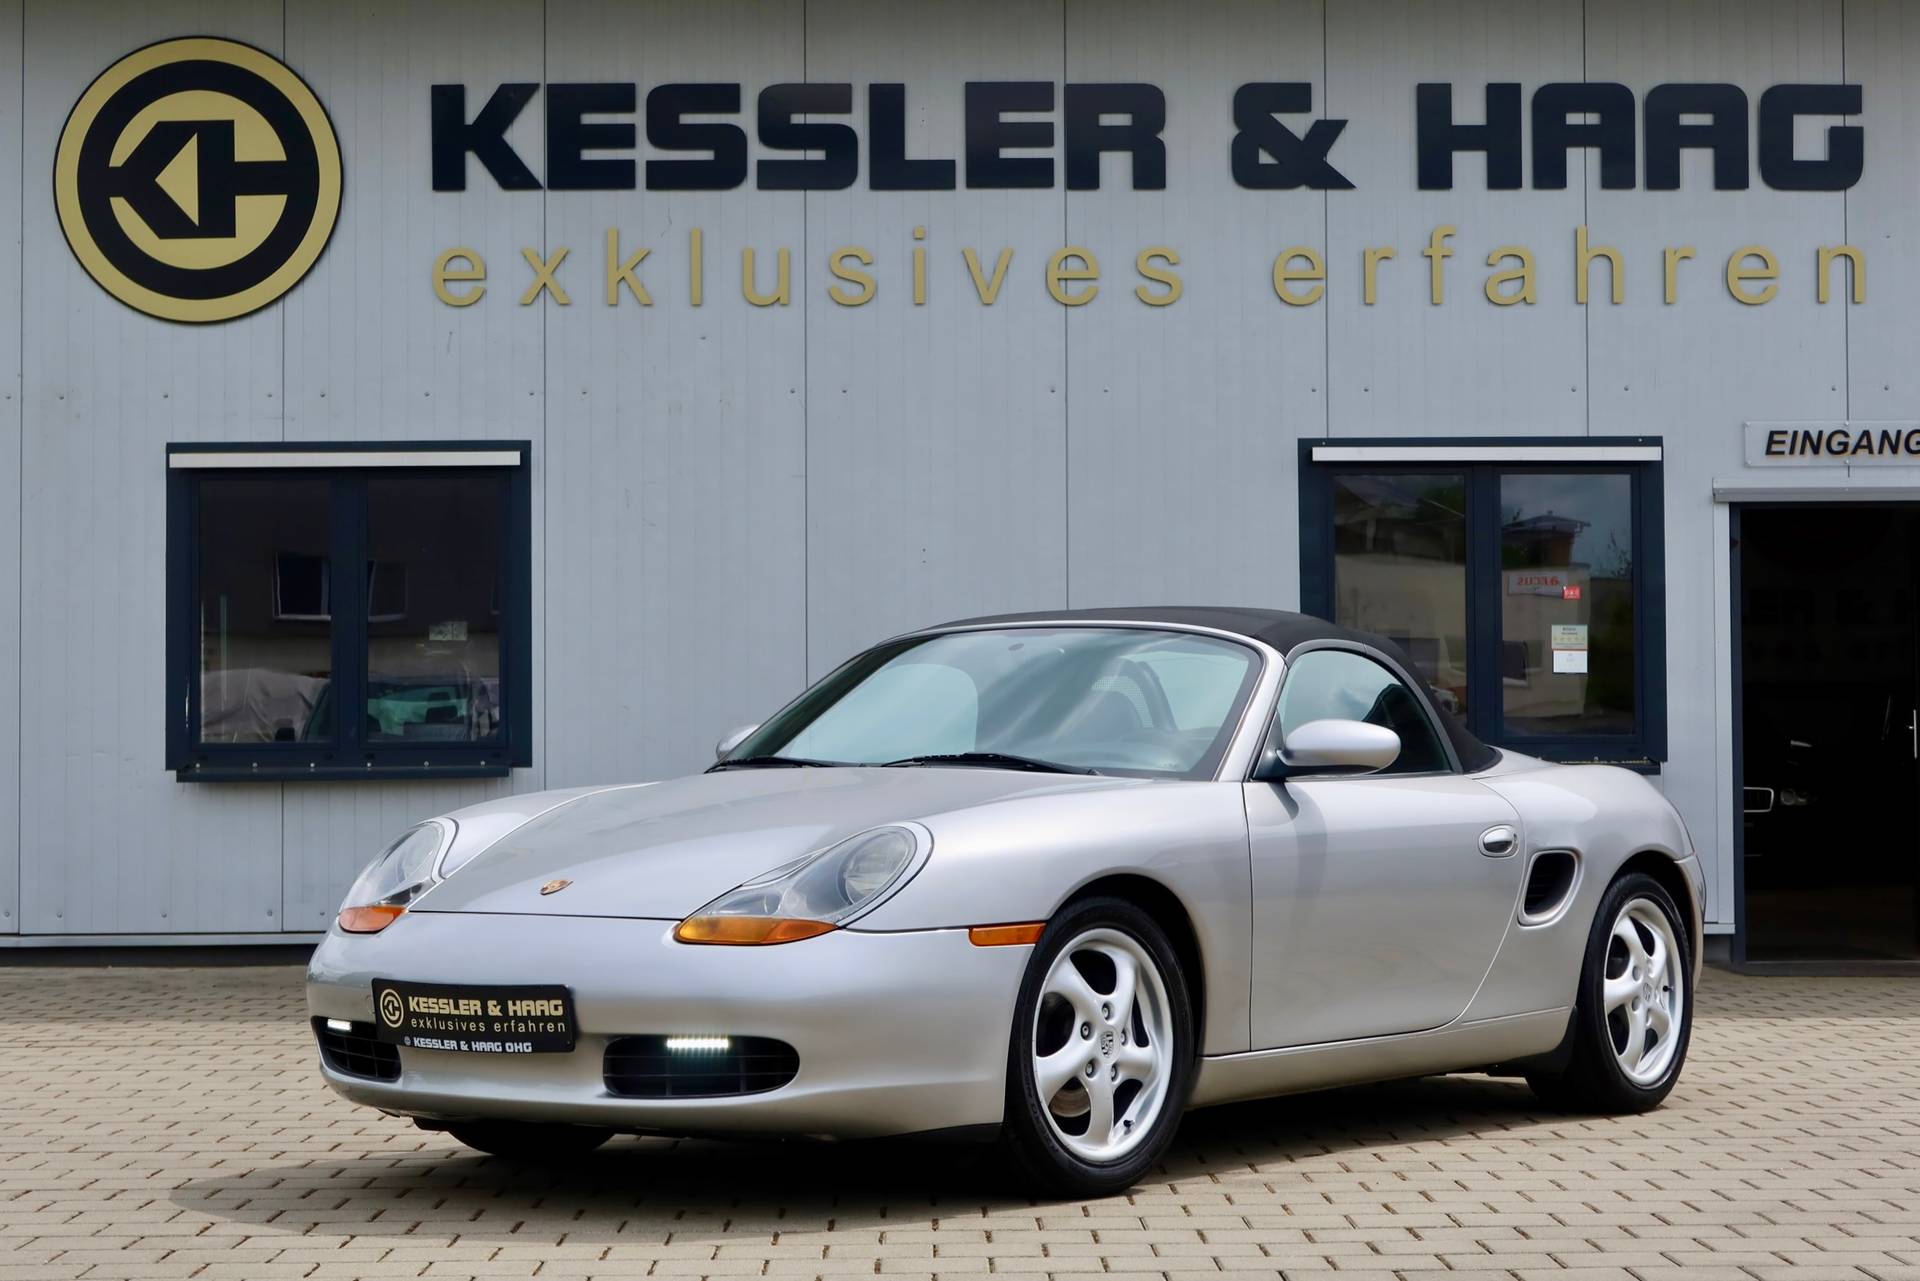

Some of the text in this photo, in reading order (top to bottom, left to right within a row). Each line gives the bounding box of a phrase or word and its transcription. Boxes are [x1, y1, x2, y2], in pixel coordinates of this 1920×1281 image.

[431, 82, 1864, 191] KESSLER & HAAG
[432, 225, 1867, 306] exklusives erfahren
[1765, 428, 1920, 456] EINGANG
[408, 996, 482, 1016] KESSLER
[487, 1000, 503, 1017] &
[507, 999, 564, 1017] HAAG
[411, 1017, 566, 1033] exklusives erfahren
[413, 1037, 533, 1053] KESSLER & HAAG OHG
